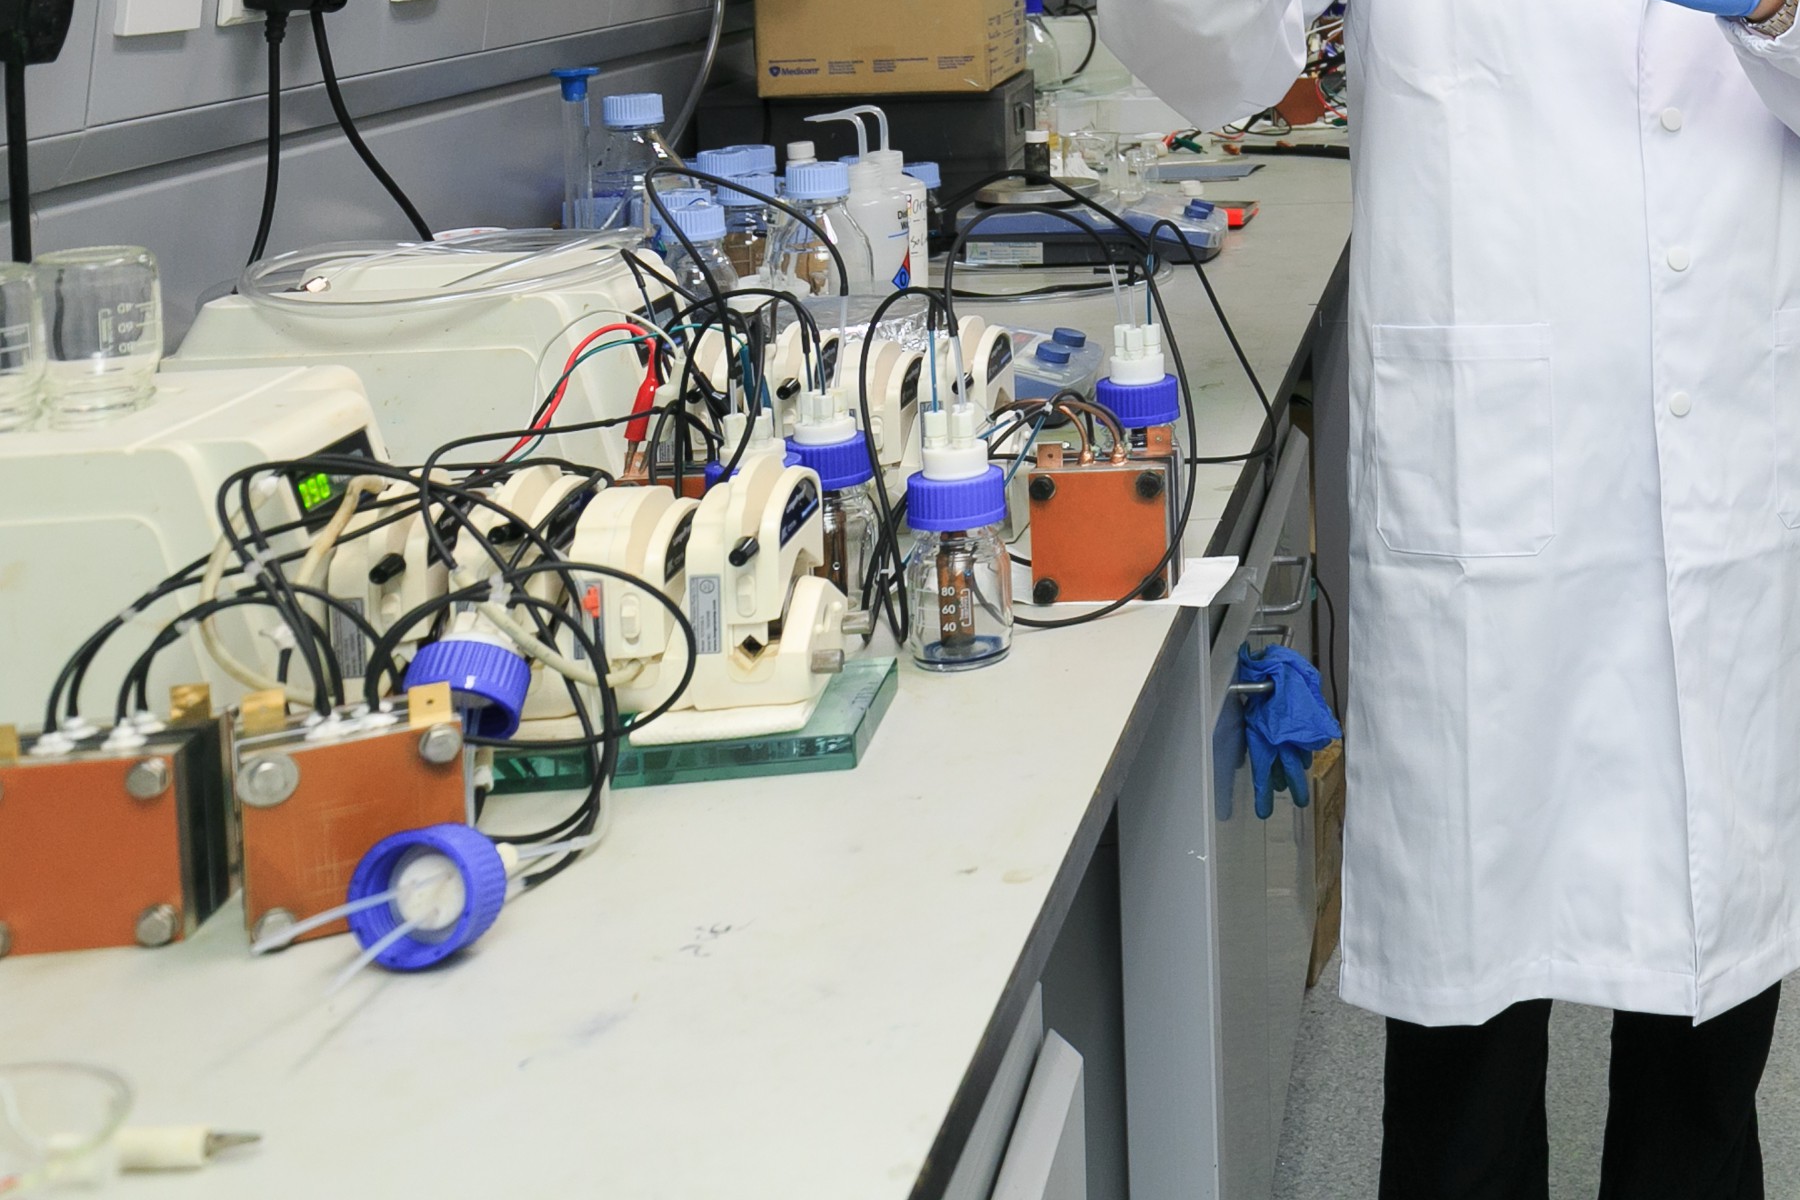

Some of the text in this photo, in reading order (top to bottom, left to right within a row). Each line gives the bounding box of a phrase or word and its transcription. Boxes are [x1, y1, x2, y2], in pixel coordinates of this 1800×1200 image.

[941, 586, 955, 597] 80
[941, 604, 956, 615] 60
[942, 621, 957, 632] 40
